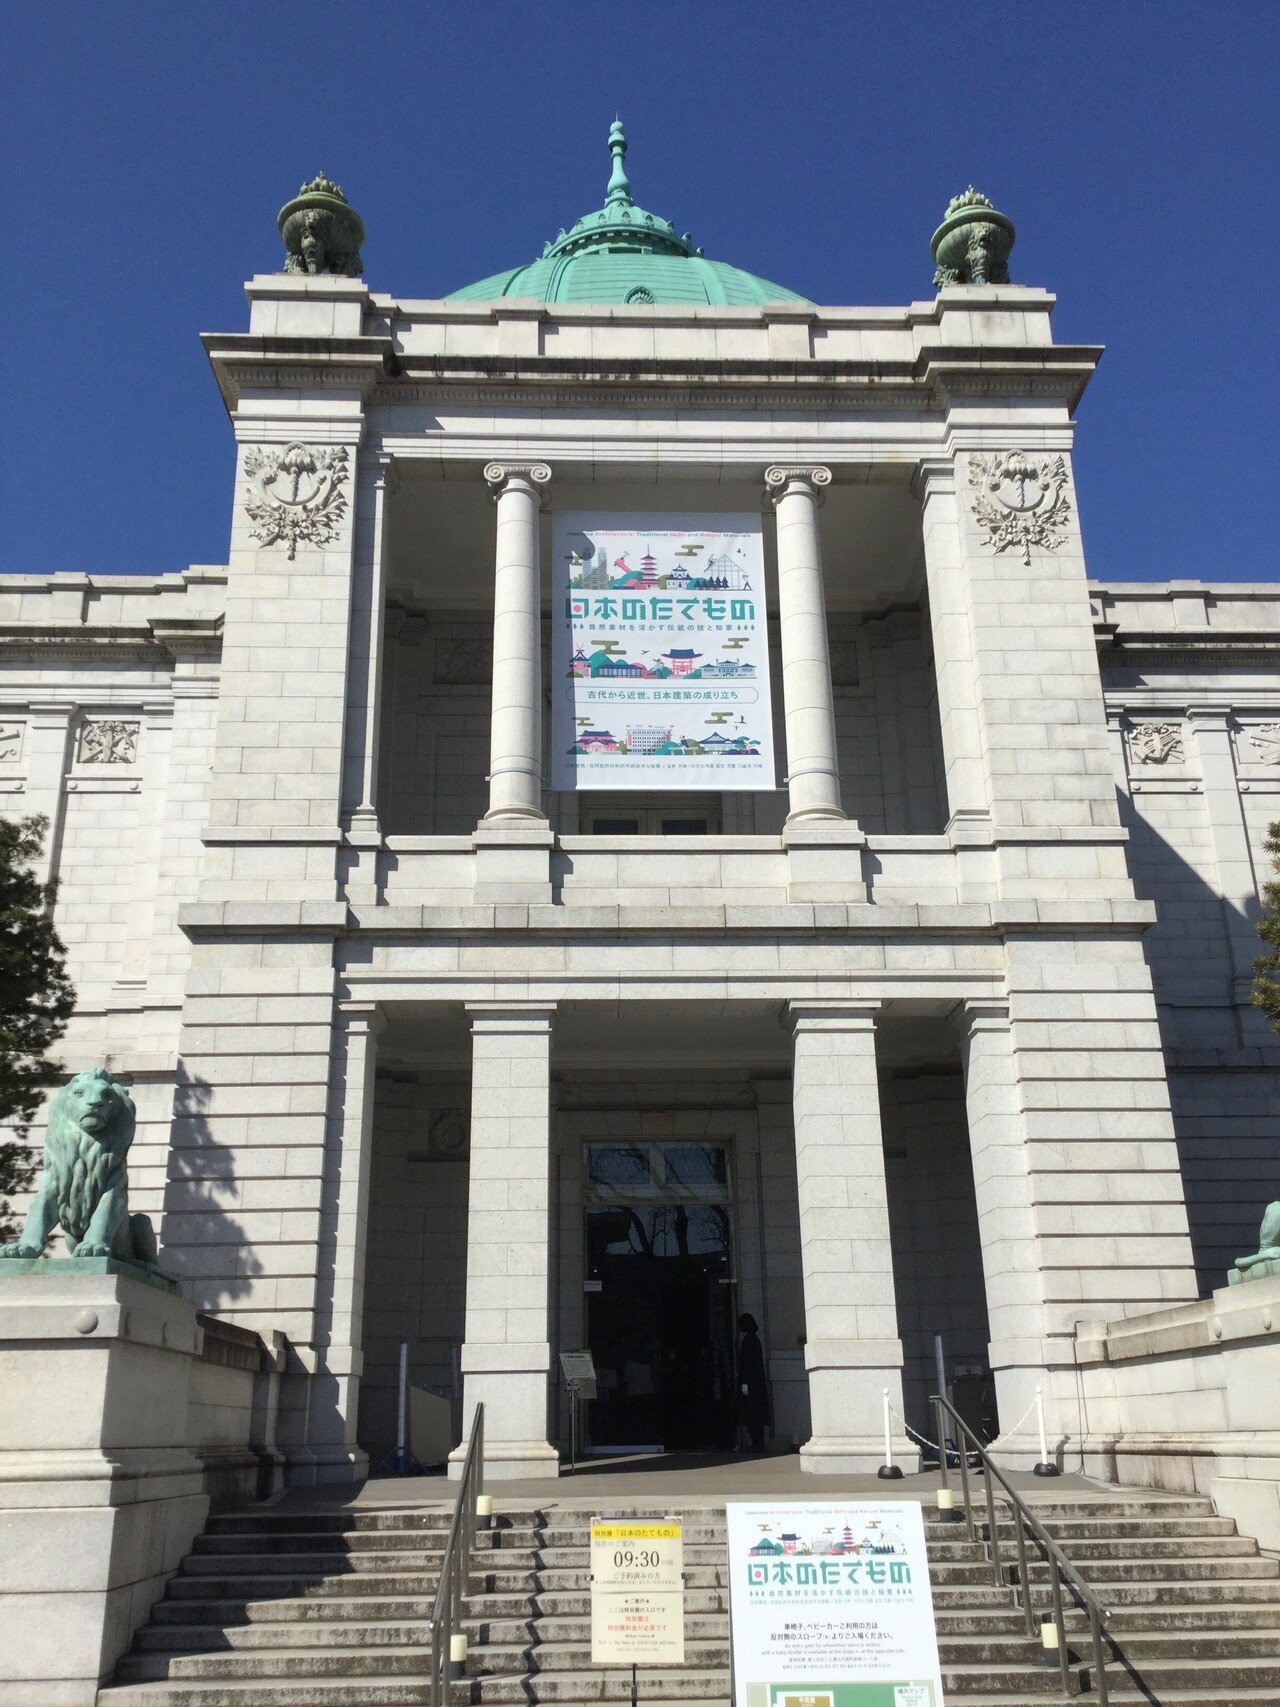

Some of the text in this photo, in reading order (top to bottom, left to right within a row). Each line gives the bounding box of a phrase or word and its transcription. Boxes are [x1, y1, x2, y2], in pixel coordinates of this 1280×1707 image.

[566, 597, 755, 620] 日本のたてもの
[587, 690, 738, 700] 古代から近世、日本建築の成り立ち
[614, 1550, 660, 1567] 09:30
[748, 1560, 912, 1586] 日本のたてもの
[784, 1622, 878, 1630] 車椅子、ベビーカーご利用の方は
